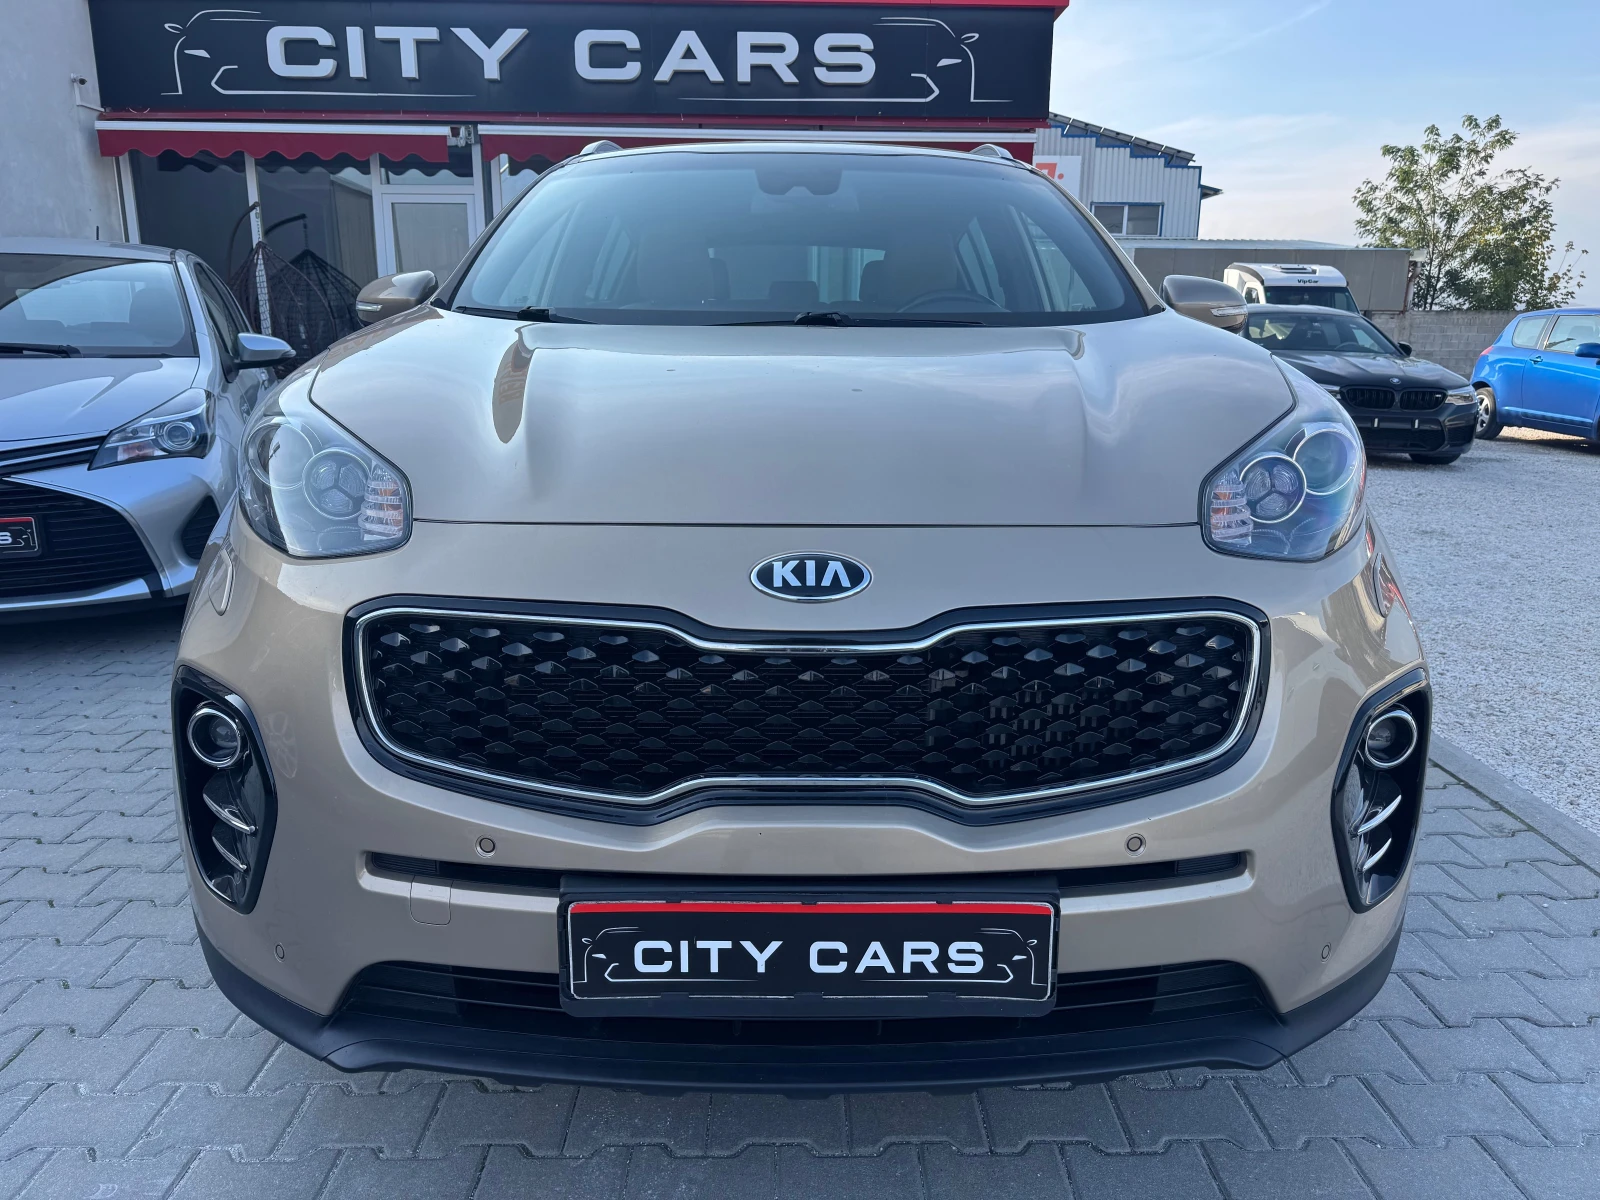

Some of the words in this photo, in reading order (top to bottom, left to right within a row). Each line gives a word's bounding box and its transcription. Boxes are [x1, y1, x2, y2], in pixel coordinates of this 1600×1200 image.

[266, 26, 529, 81] CITY
[574, 29, 876, 86] CARS
[771, 559, 852, 588] KIA
[634, 940, 784, 973] CITY
[809, 941, 984, 974] CARS
